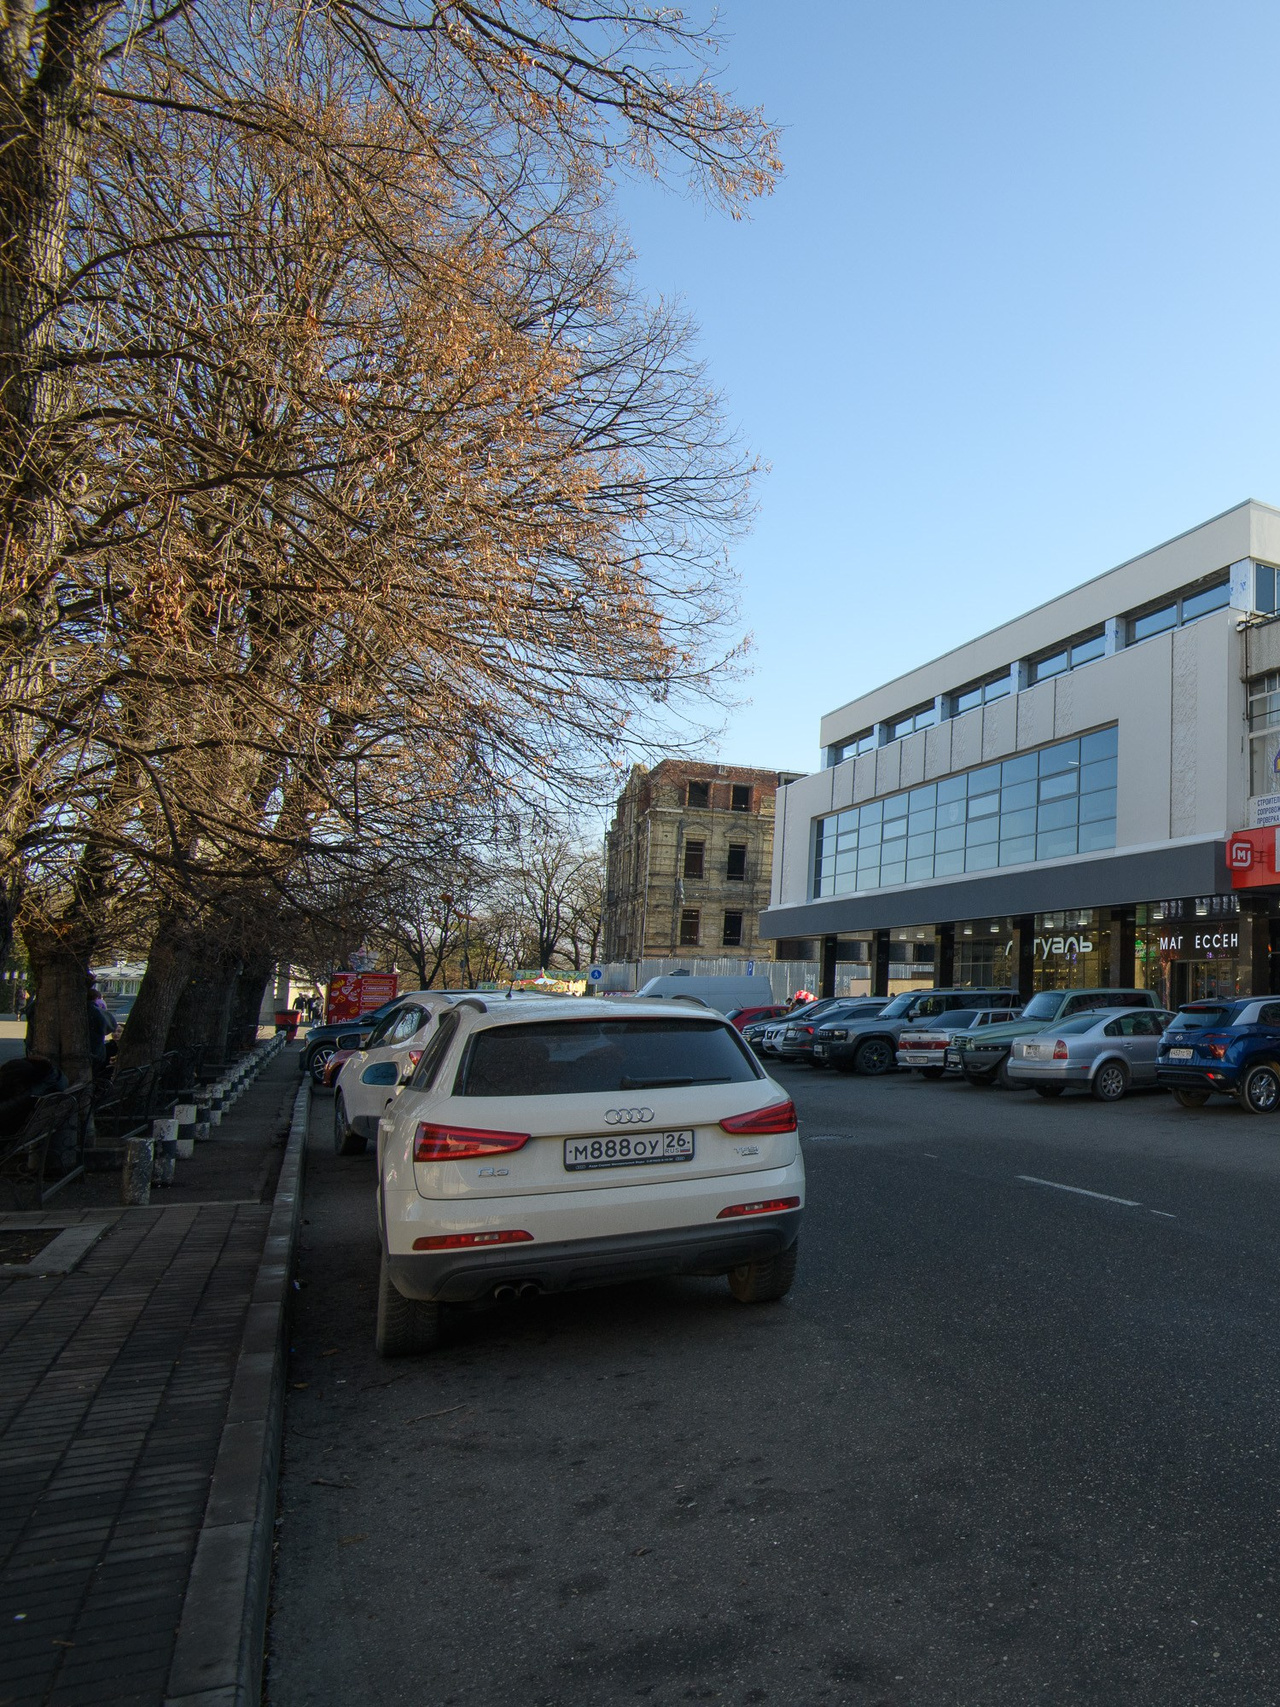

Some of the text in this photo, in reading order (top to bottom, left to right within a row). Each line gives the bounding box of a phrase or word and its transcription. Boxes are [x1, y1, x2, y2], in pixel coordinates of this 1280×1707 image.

[1257, 814, 1280, 824] ПРОВЕРКА
[1160, 933, 1238, 950] МАГ ЕССЕН
[574, 1132, 686, 1161] М888ОУ 26
